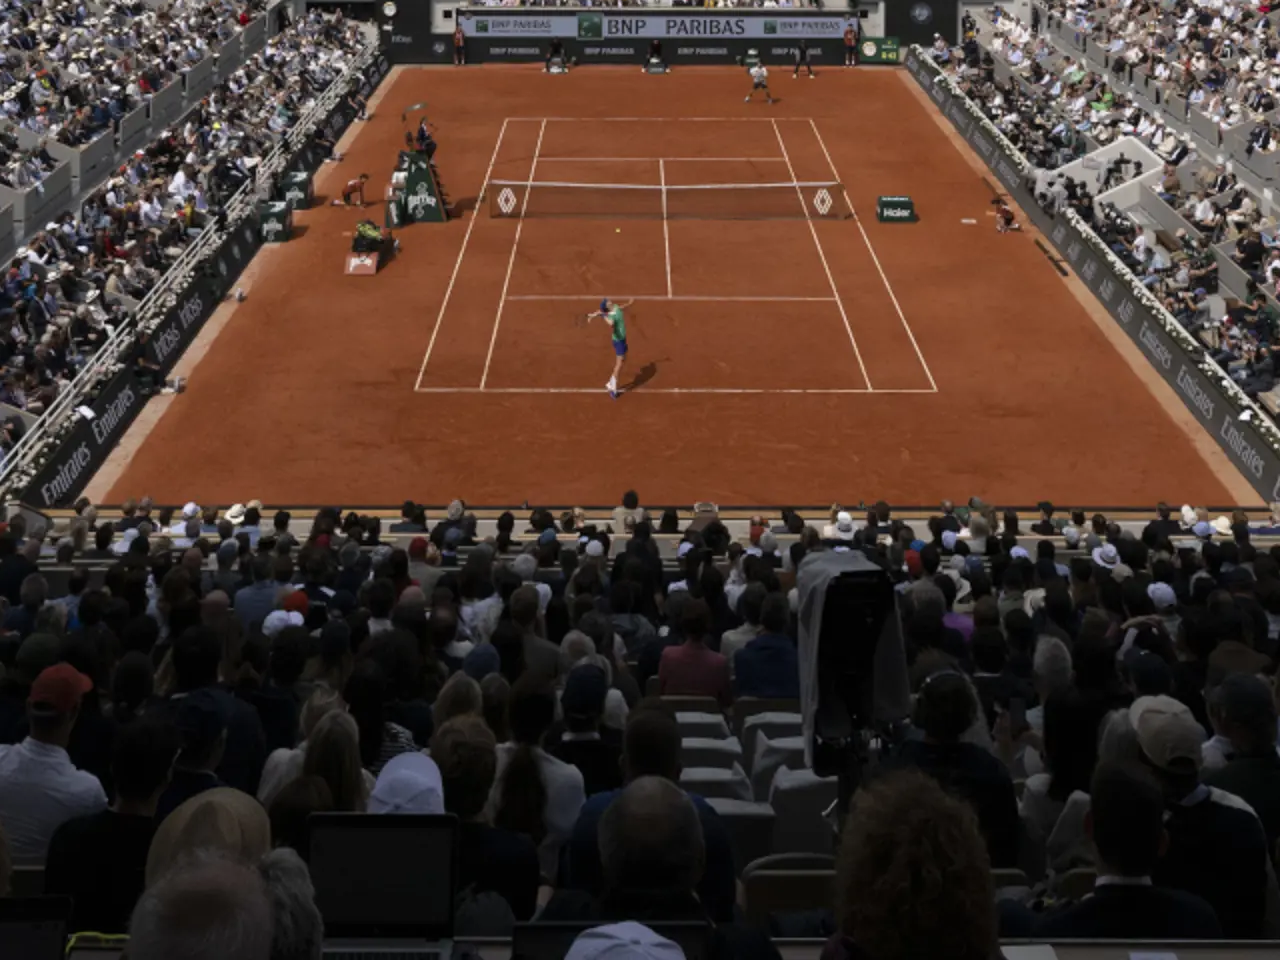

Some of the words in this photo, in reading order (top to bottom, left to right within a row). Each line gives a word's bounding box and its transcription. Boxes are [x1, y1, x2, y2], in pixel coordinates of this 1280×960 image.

[607, 19, 647, 35] BNP
[665, 19, 746, 35] PARIBAS
[1176, 364, 1215, 420] Emirates
[40, 441, 92, 506] Emirates
[91, 383, 135, 445] Emirates
[1220, 414, 1266, 479] Emirates
